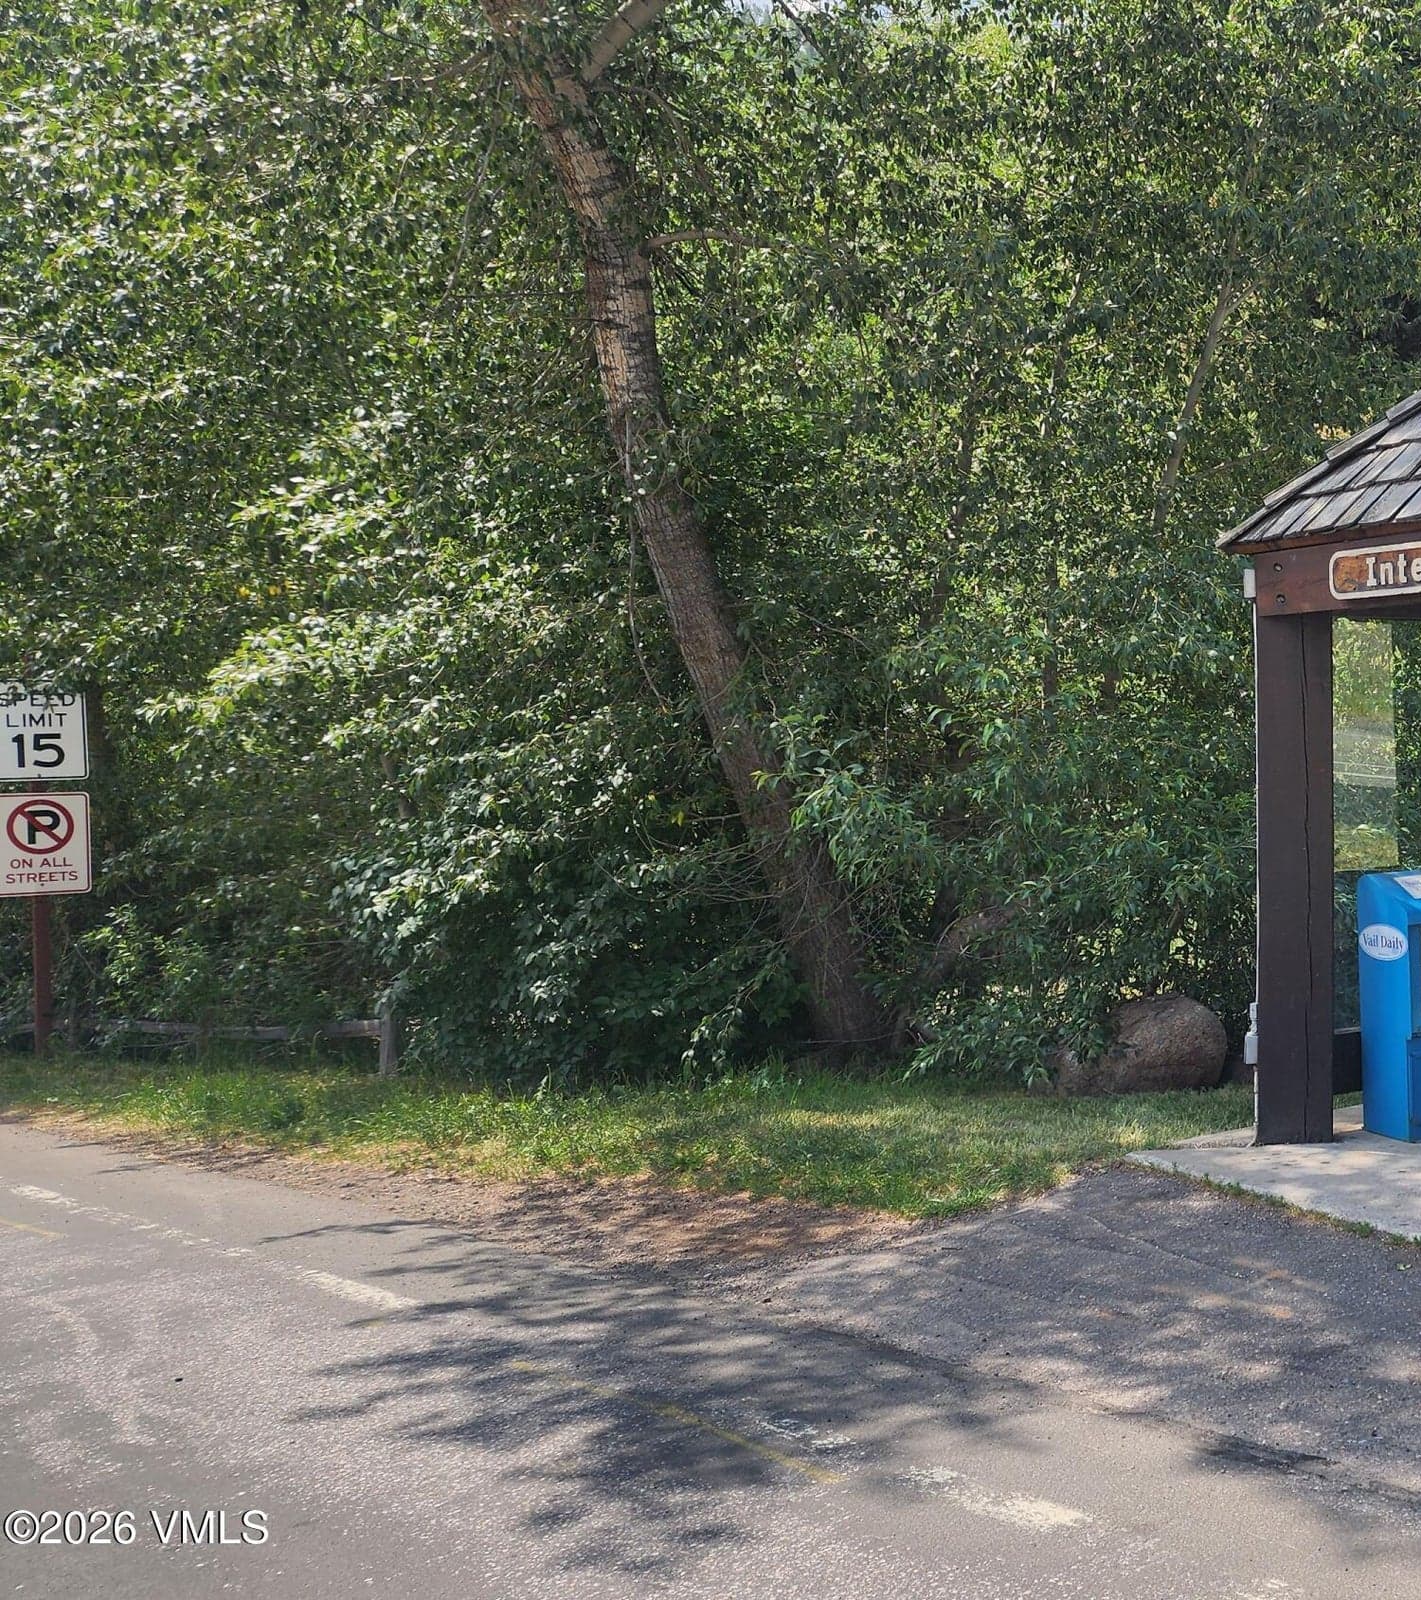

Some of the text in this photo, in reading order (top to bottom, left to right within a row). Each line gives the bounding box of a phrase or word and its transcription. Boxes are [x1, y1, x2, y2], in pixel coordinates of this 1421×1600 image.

[6, 712, 67, 728] LIMIT
[12, 733, 65, 768] 15
[10, 857, 73, 870] ON ALL
[5, 871, 79, 884] STREETS
[1362, 933, 1403, 954] Vail Daily
